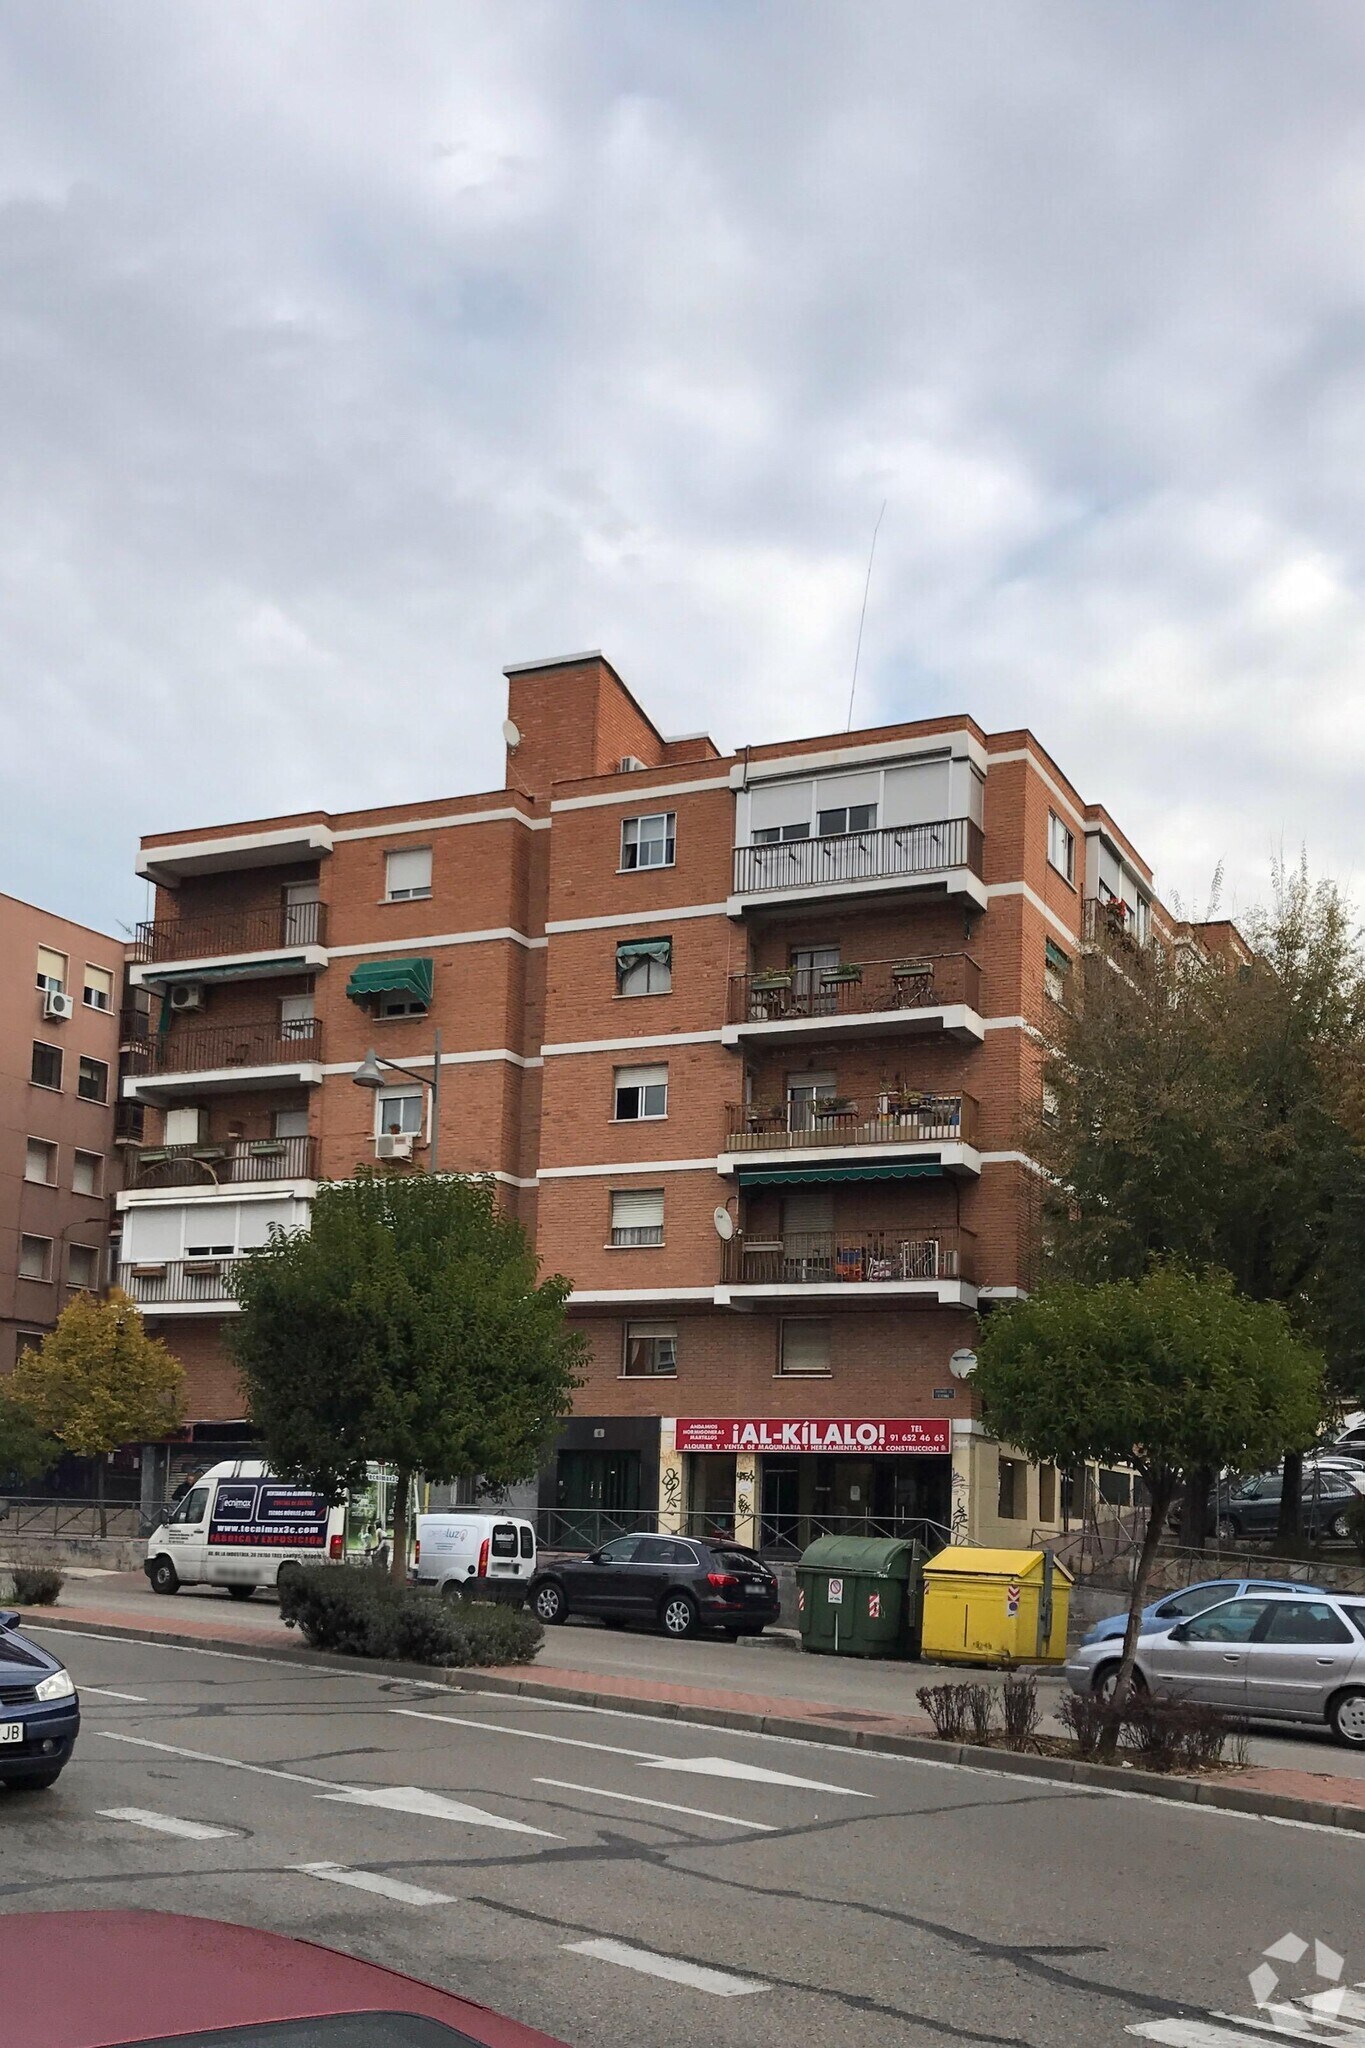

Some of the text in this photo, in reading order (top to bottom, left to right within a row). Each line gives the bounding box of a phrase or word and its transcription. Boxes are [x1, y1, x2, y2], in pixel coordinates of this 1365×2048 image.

[732, 1421, 886, 1446] ¡AL-KÍLALO!
[910, 1425, 923, 1433] TEL
[889, 1434, 944, 1442] 91 652 46 65
[758, 1443, 802, 1451] MAQUINARIA
[217, 1494, 252, 1512] Tecnimax
[216, 1525, 319, 1535] www.tecnimax3c.com
[253, 1535, 259, 1544] Y
[2, 1725, 20, 1740] JB
